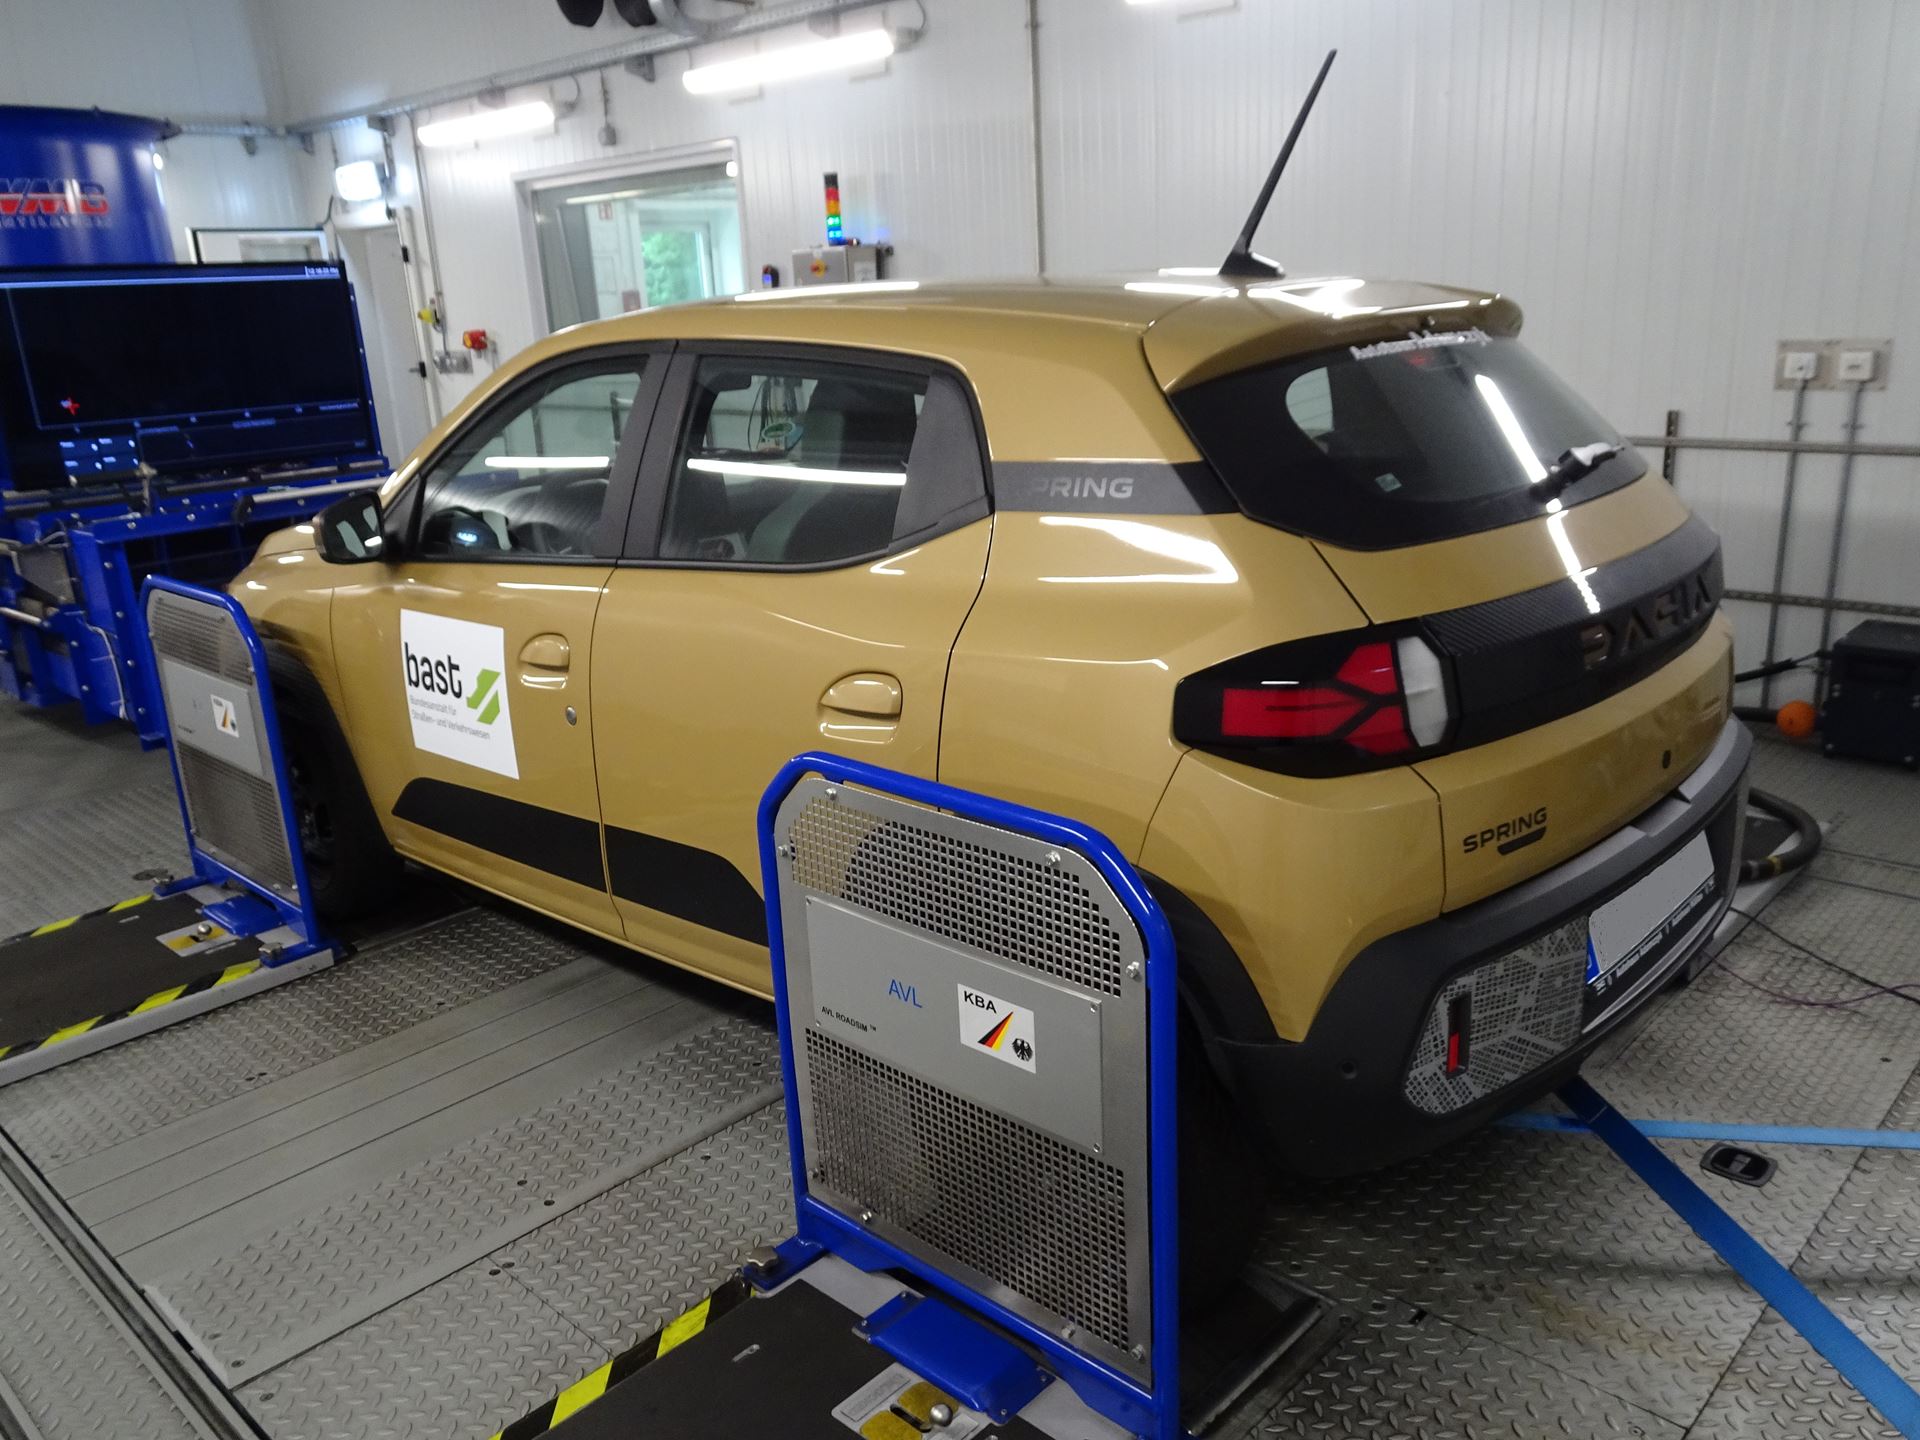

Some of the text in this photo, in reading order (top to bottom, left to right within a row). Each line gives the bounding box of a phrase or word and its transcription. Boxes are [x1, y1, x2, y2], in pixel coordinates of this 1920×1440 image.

[404, 642, 463, 699] bast
[1463, 806, 1547, 854] SPRING
[888, 979, 923, 1009] AVL
[963, 990, 998, 1014] KBA
[821, 1005, 835, 1019] AVL
[835, 1011, 868, 1034] ROADSIM
